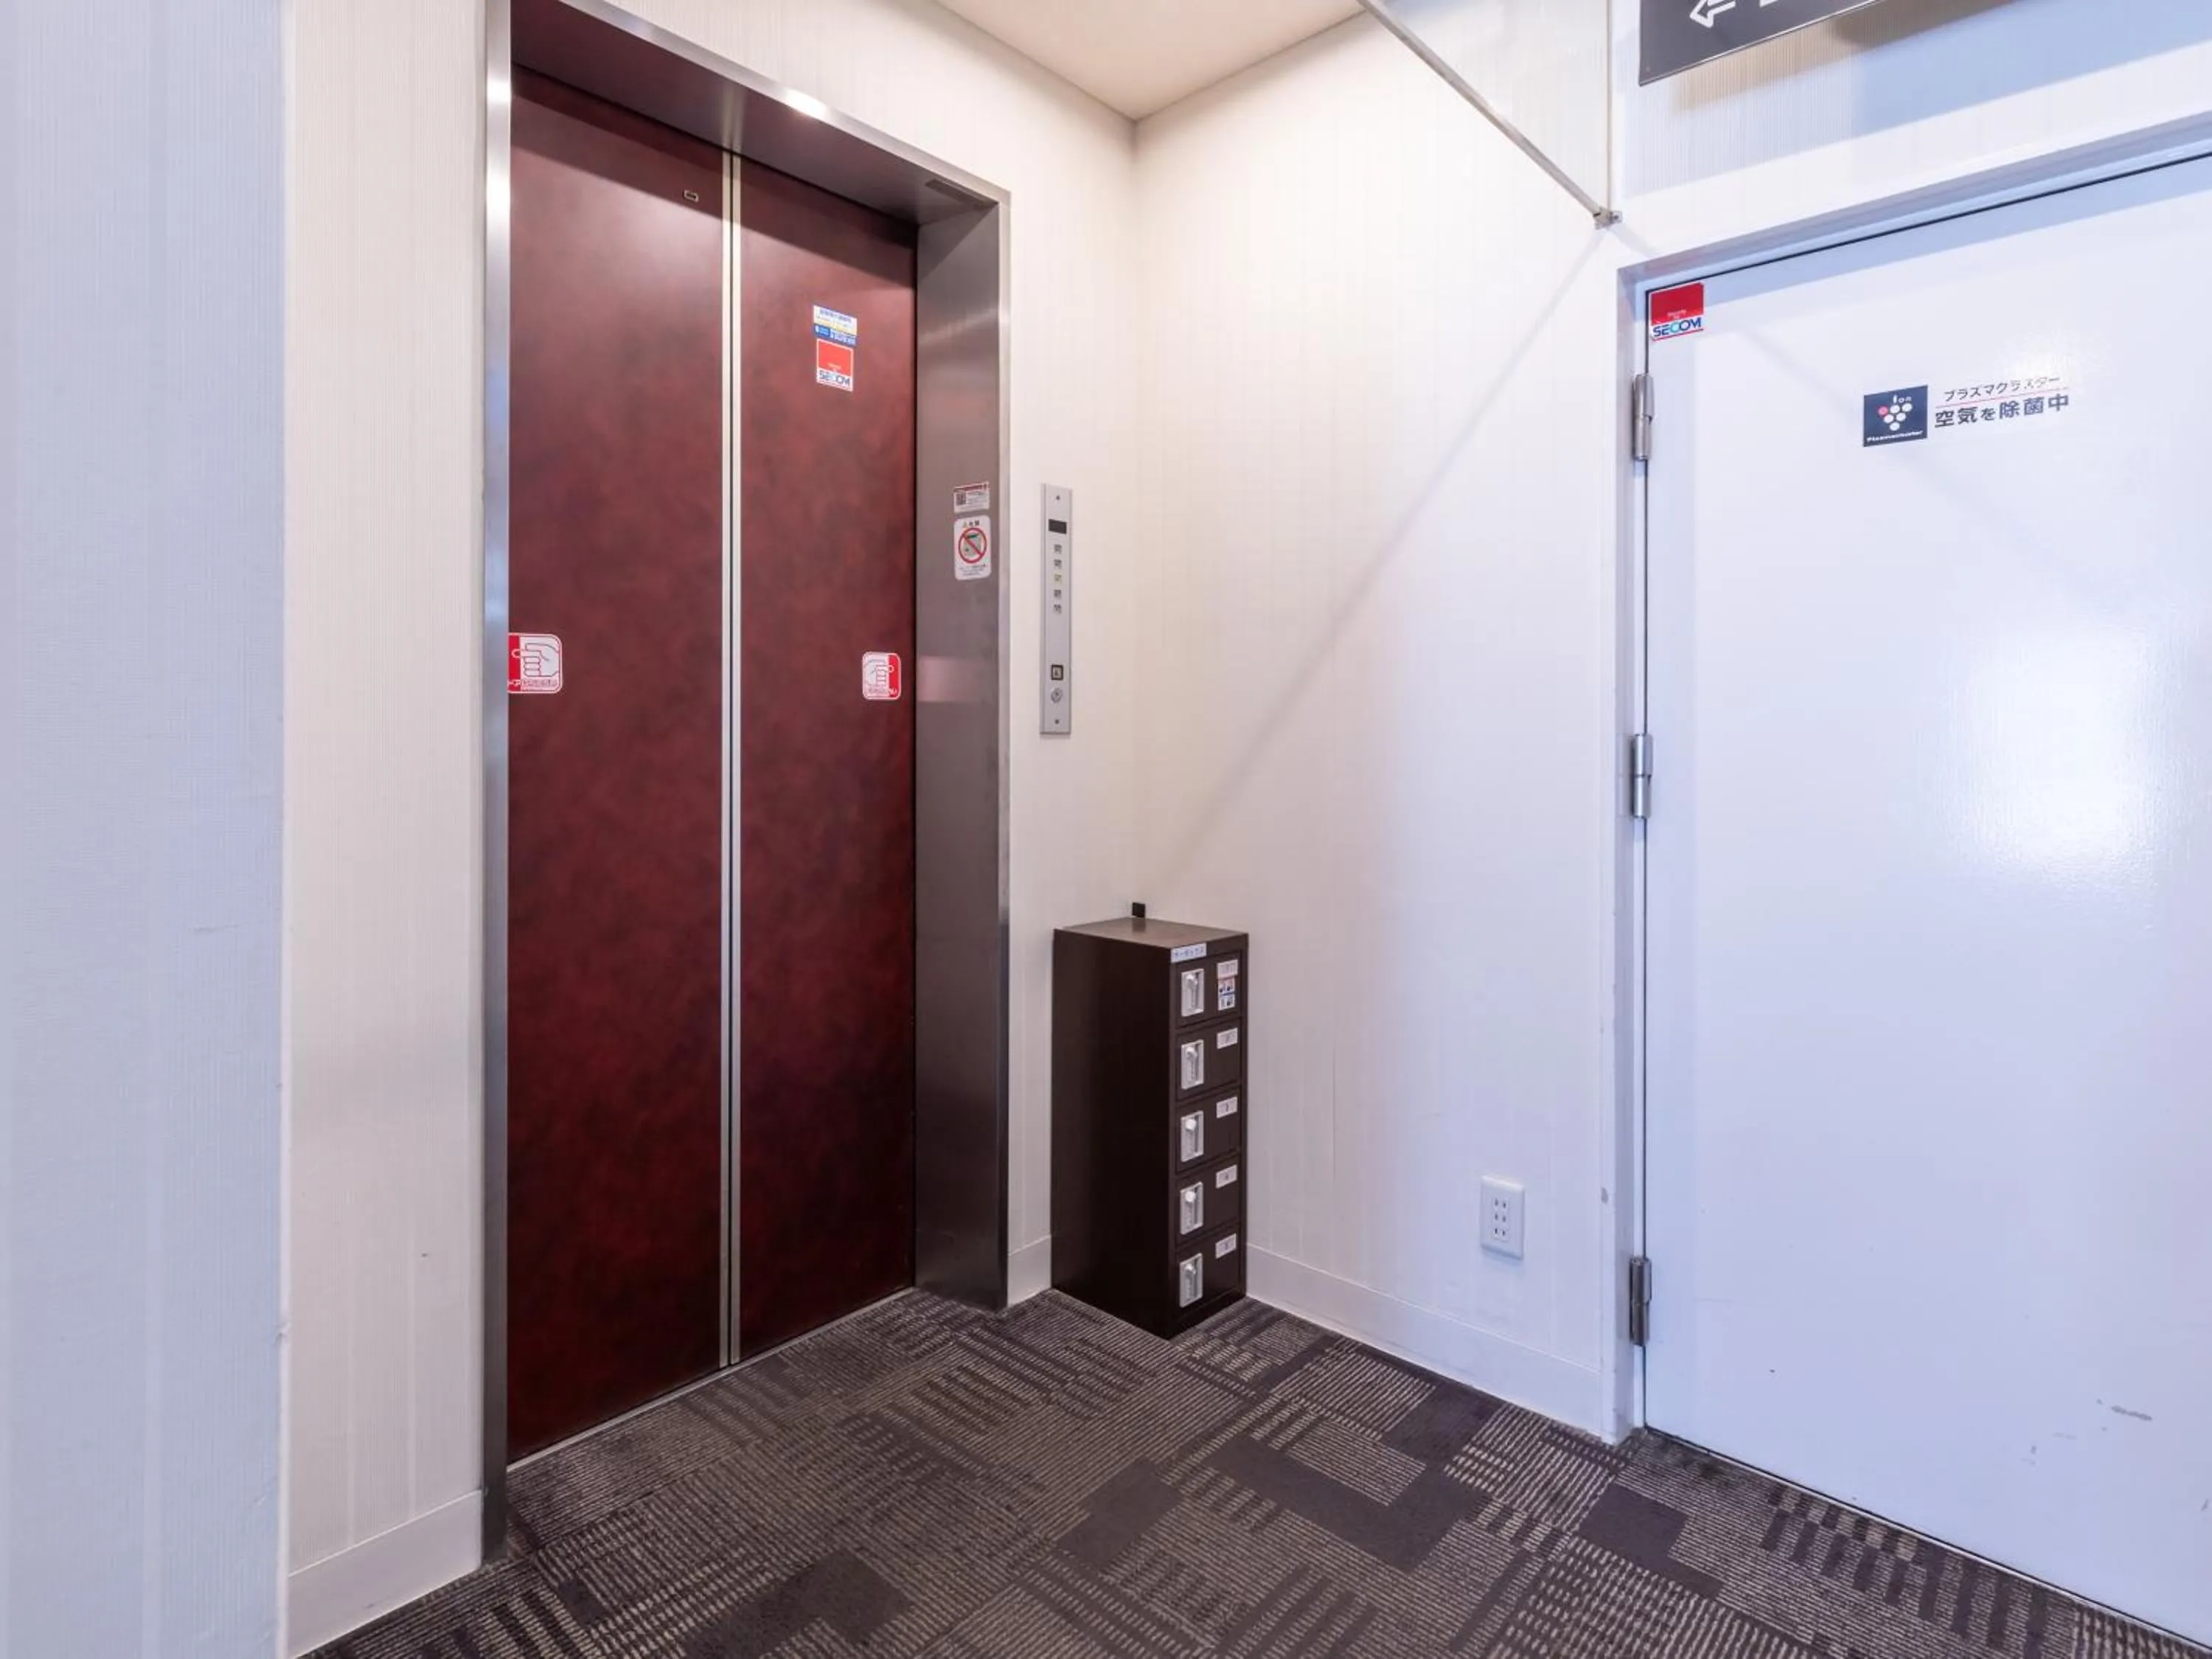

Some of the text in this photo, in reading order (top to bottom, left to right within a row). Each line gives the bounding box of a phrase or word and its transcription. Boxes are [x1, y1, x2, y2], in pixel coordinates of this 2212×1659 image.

[1652, 317, 1701, 336] SECOM
[1935, 393, 2068, 428] 空気を除菌中
